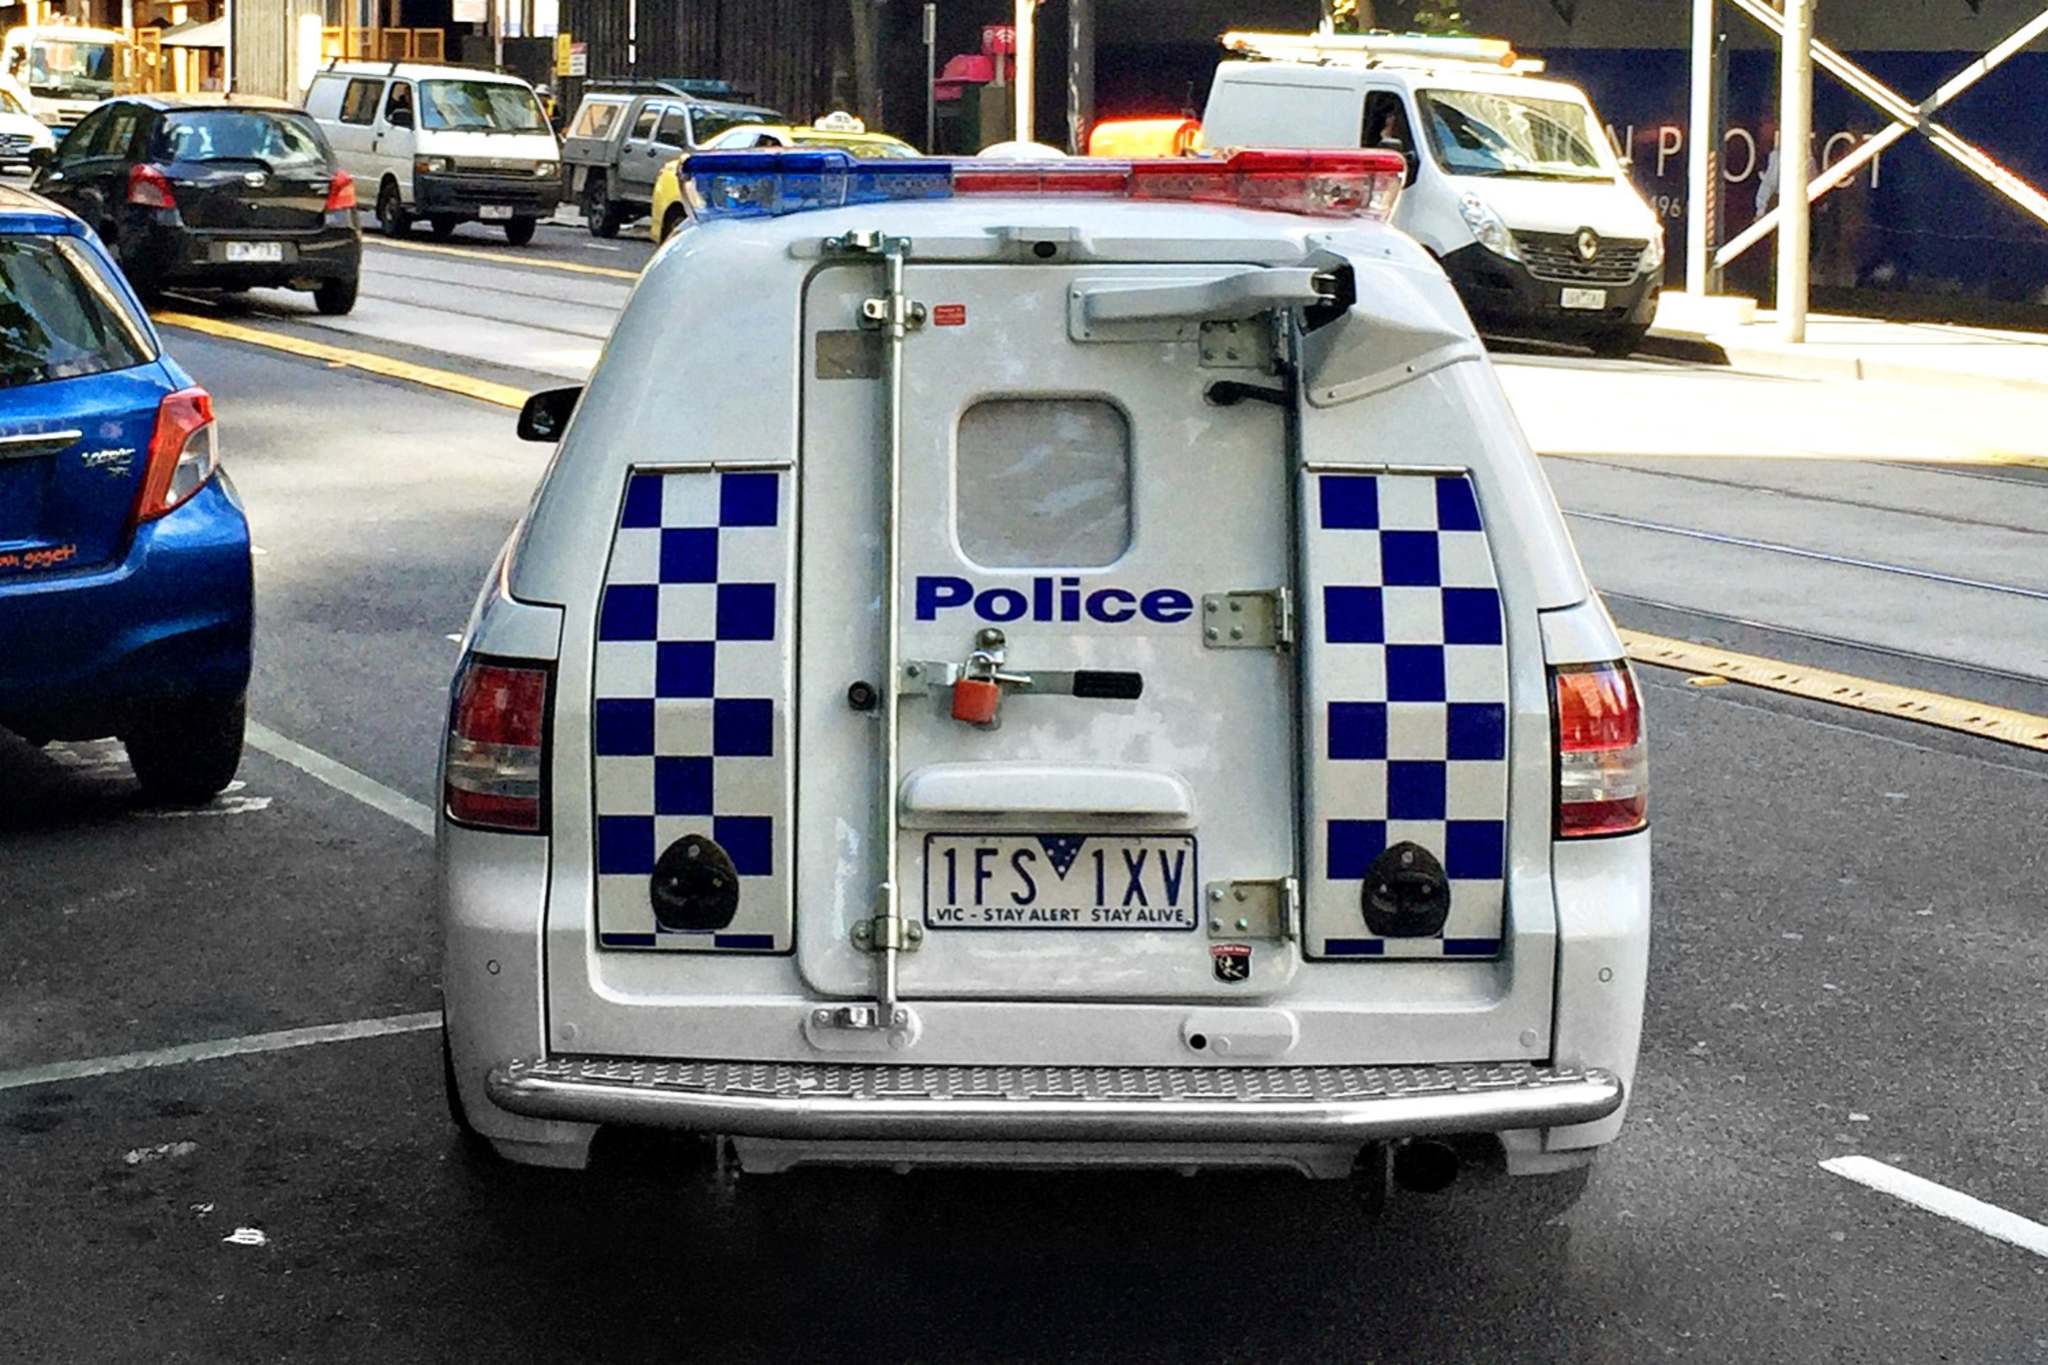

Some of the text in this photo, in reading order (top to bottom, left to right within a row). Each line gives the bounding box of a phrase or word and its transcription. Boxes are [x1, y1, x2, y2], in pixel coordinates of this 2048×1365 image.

[915, 576, 1194, 623] Police
[943, 847, 1186, 907] 1FS 1XV
[936, 907, 964, 922] VIC
[984, 907, 1025, 922] STAY
[1028, 907, 1080, 922] ALERT
[1091, 908, 1132, 922] STAY
[1136, 908, 1184, 922] ALIVE
